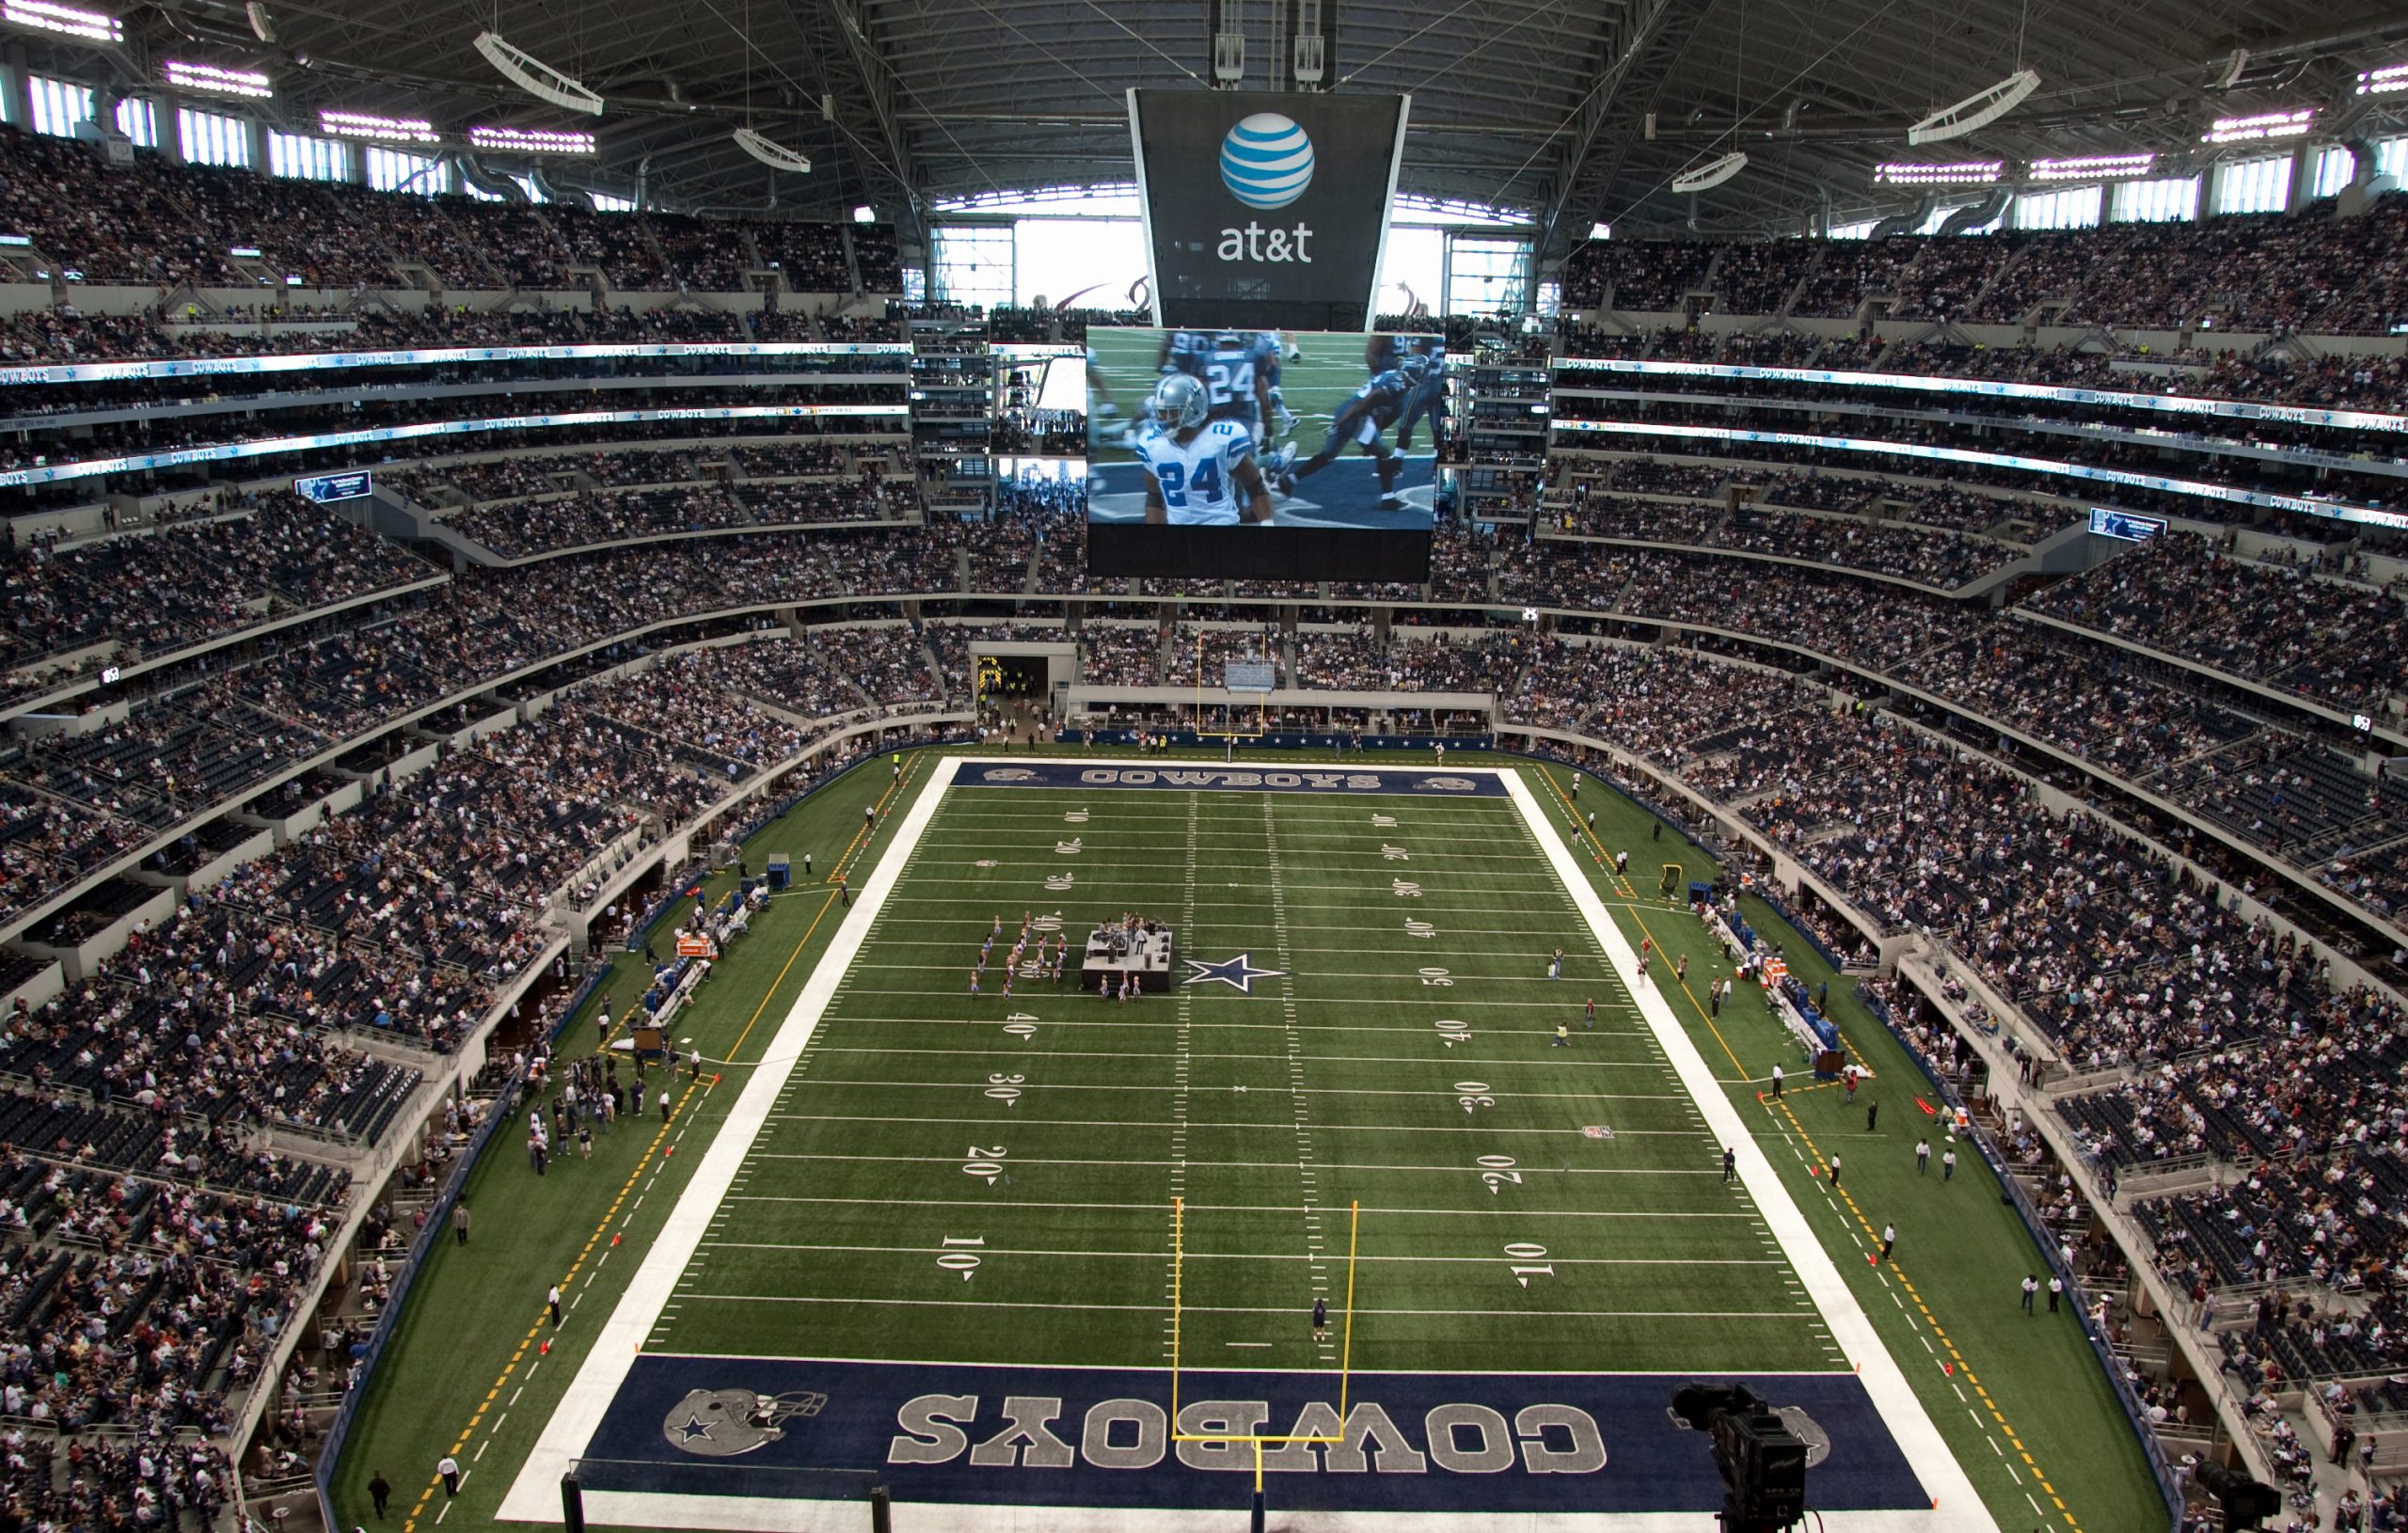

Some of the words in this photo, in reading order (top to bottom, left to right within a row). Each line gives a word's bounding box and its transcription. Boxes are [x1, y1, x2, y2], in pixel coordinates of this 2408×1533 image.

[1217, 221, 1313, 262] at&t
[507, 347, 549, 358] COWBOYS
[684, 344, 732, 355] COWBOYS
[192, 360, 237, 372] COWBOYS
[356, 354, 394, 365] COWBOYS
[1567, 359, 1615, 371] COWBOYS
[100, 363, 149, 379] COWBOYS
[1760, 369, 1807, 380] COWBOYS
[1206, 363, 1256, 404] 24
[2095, 391, 2134, 405] COWBOYS
[2173, 399, 2216, 413] COWBOYS
[657, 409, 705, 419] COWBOYS
[2259, 406, 2305, 421] COWBOYS
[484, 418, 527, 429] COWBOYS
[2353, 415, 2404, 431] COWBOYS
[335, 432, 374, 445] COWBOYS
[1776, 434, 1823, 445] COWBOYS
[171, 448, 216, 464] COWBOYS
[78, 459, 127, 476] COWBOYS
[1157, 458, 1224, 508] 24
[2106, 470, 2146, 485] COWBOYS
[2185, 483, 2227, 498] COWBOYS
[2270, 495, 2316, 513] COWBOYS
[2362, 512, 2408, 529] COWBOY
[1080, 768, 1382, 789] COWBOYS
[1404, 922, 1436, 939] 40
[1418, 967, 1454, 987] 50
[1003, 1012, 1039, 1034] 40
[1434, 1019, 1472, 1042] 40
[984, 1073, 1025, 1098] 30
[1453, 1082, 1496, 1107] 30
[962, 1146, 1007, 1176] 20
[1476, 1155, 1523, 1185] 20
[936, 1234, 985, 1270] 10
[1504, 1242, 1555, 1277] 10
[887, 1395, 1608, 1474] COWBOYS
